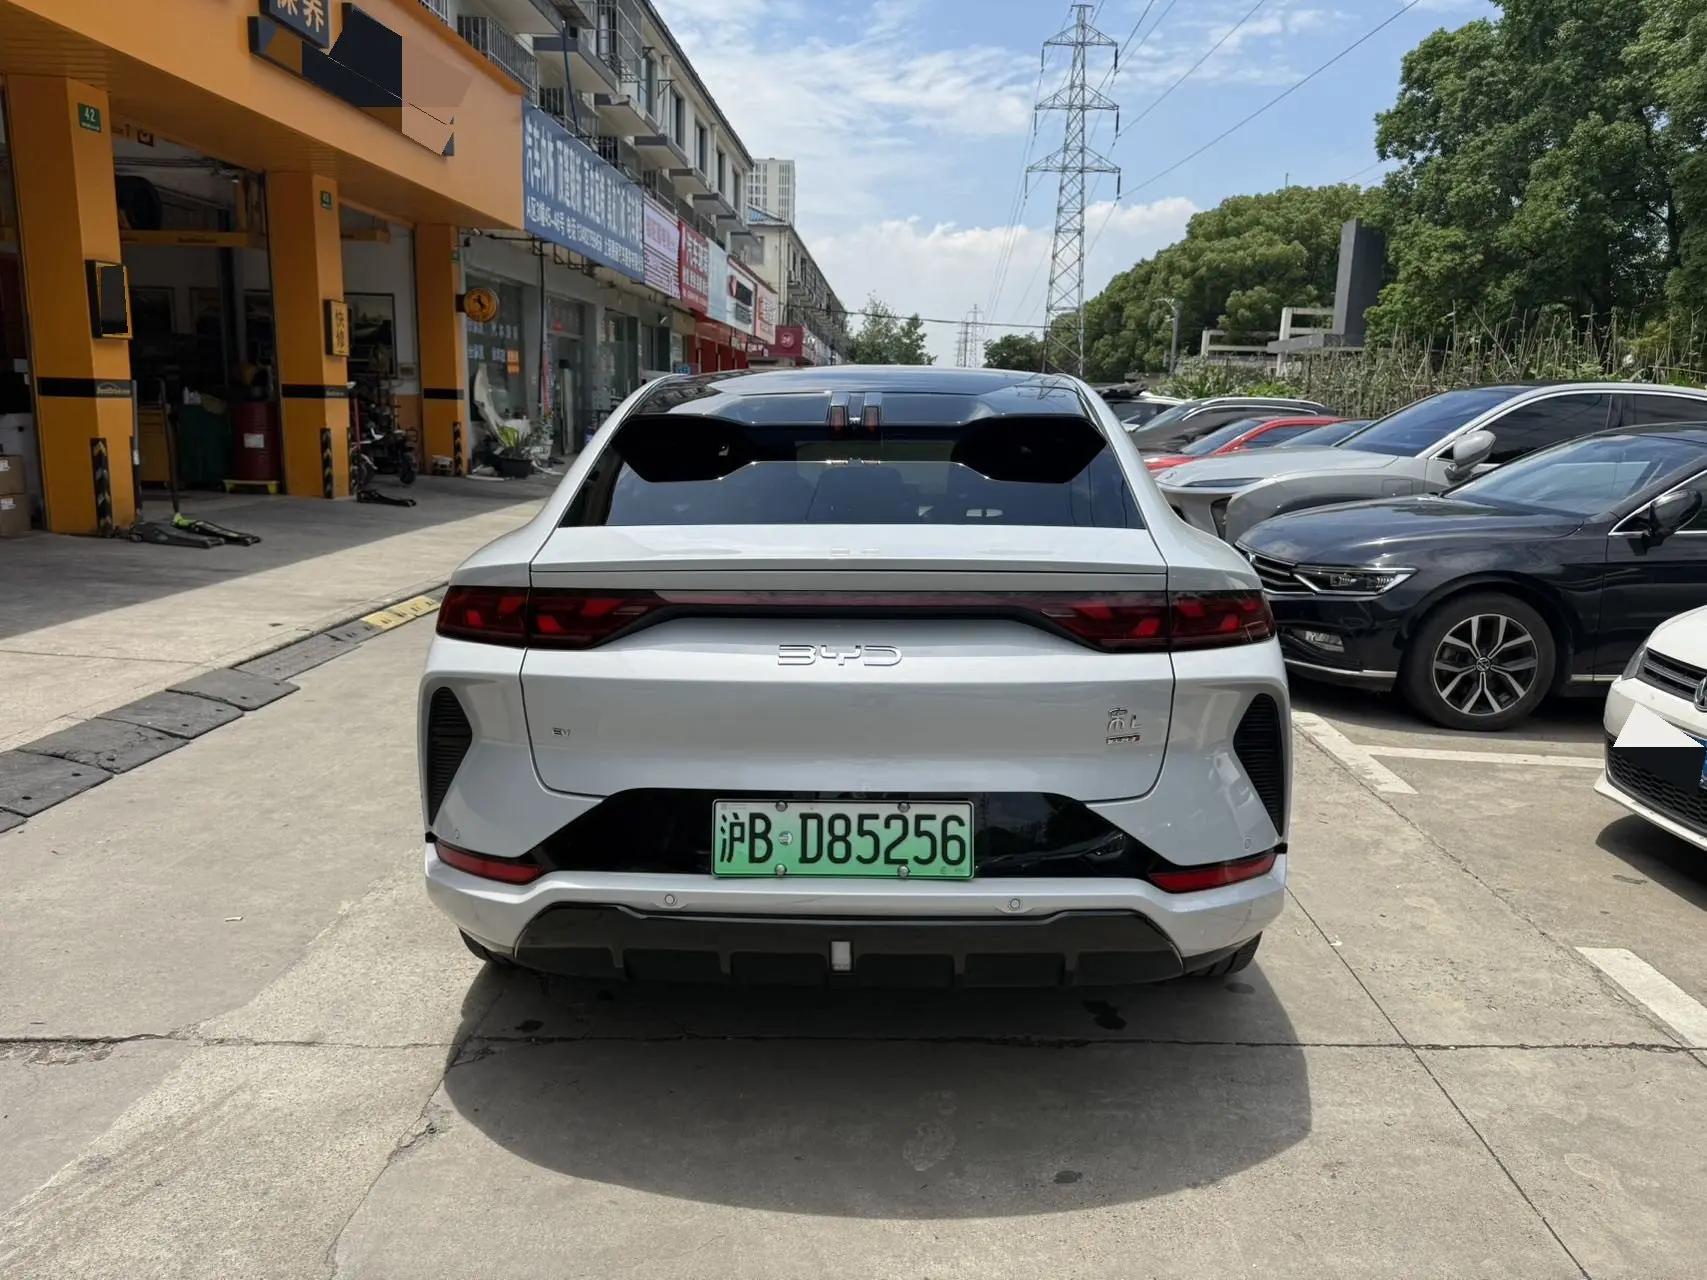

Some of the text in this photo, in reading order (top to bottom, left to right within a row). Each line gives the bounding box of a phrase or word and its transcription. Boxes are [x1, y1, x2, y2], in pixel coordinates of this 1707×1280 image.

[84, 107, 97, 122] 42
[777, 644, 903, 667] BYD
[719, 811, 967, 866] 沪B D85256
